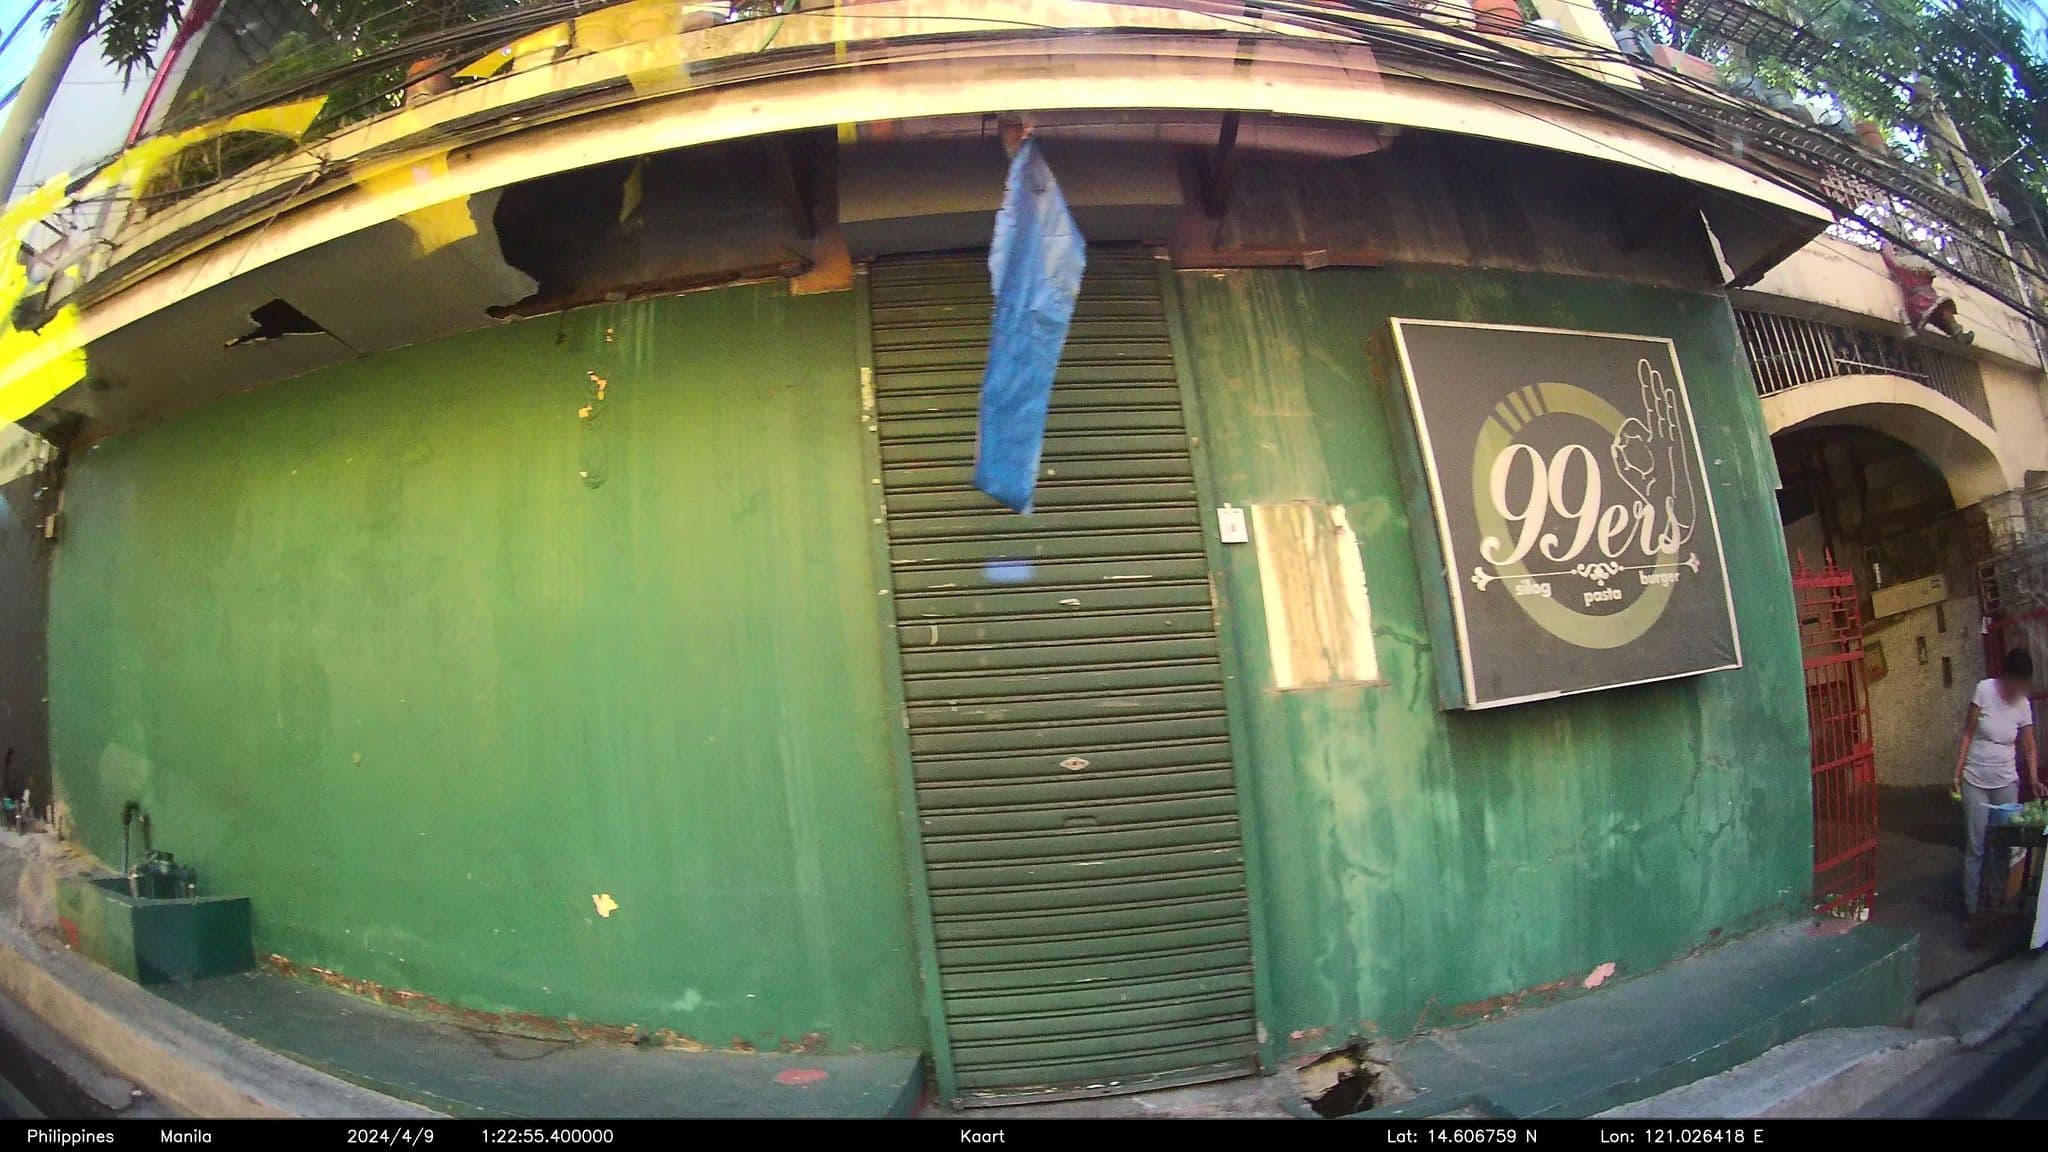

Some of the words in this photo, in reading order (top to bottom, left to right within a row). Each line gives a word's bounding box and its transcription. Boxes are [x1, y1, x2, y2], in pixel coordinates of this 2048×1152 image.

[1479, 444, 1681, 566] 99ers
[1515, 579, 1552, 598] silog
[1583, 587, 1622, 606] pasta
[1639, 570, 1680, 586] burger
